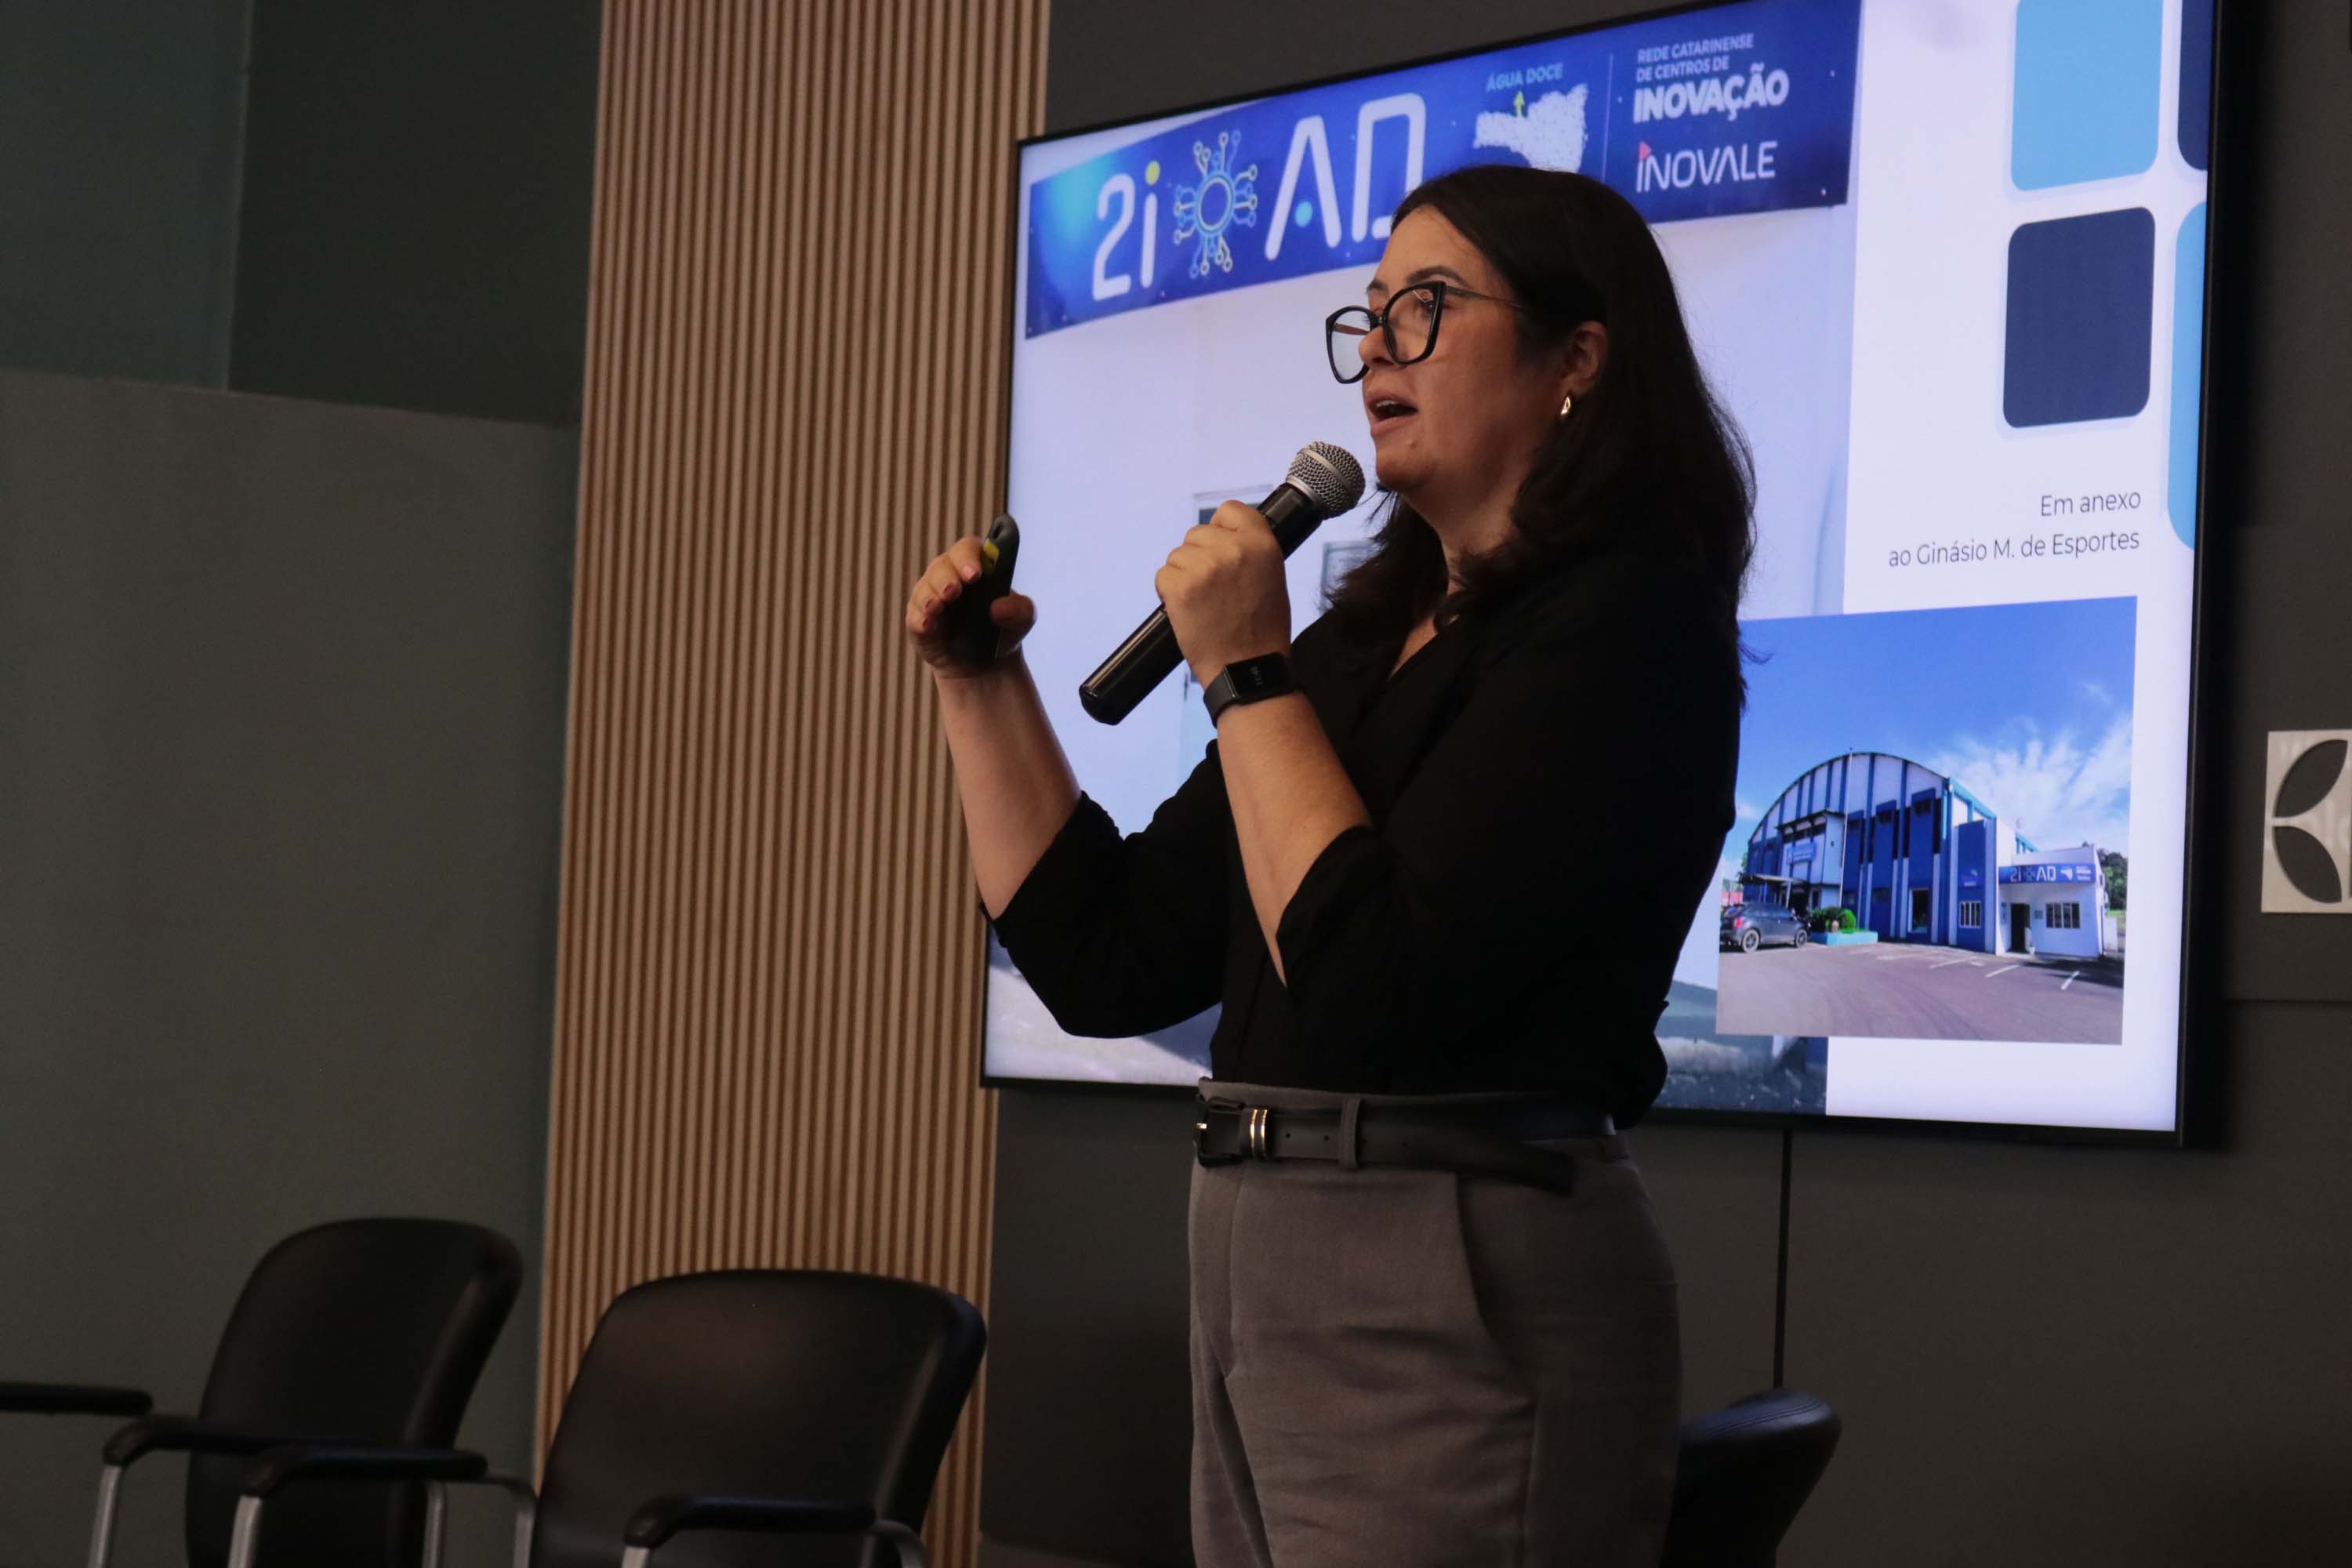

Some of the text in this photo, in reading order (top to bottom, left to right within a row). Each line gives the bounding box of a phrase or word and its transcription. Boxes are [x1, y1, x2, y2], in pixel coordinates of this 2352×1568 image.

[1638, 33, 1755, 63] REDE CATARINENSE
[1526, 62, 1563, 85] DOCE
[1636, 56, 1730, 82] DE CENTROS DE
[1633, 62, 1790, 124] INOVAÇÃO
[2040, 491, 2141, 517] Em anexo
[1889, 530, 2140, 567] ao Ginásio M. de Esportes
